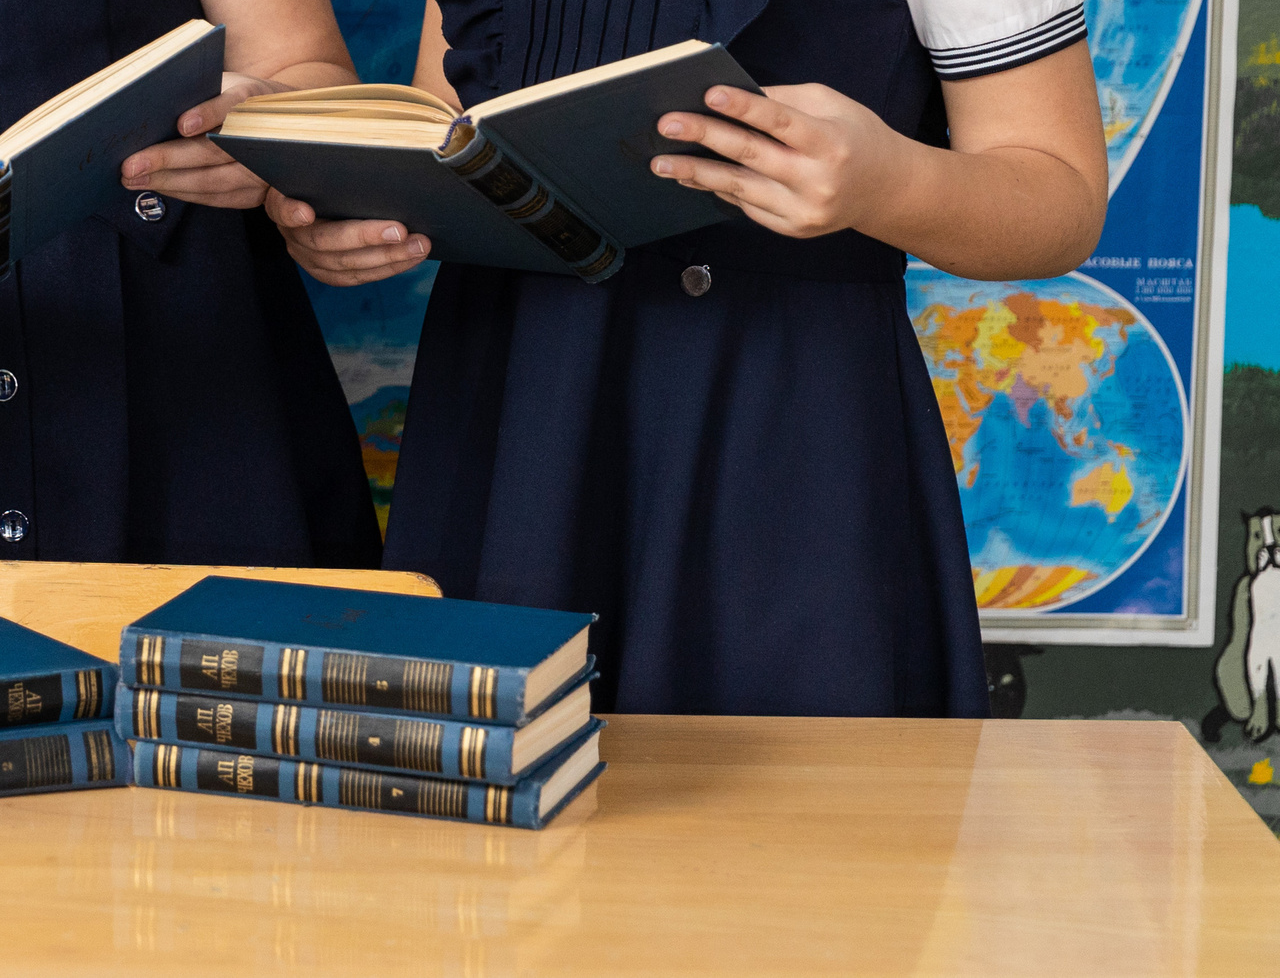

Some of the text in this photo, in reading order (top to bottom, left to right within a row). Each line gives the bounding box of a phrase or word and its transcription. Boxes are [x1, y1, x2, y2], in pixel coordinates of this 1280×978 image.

[1082, 256, 1194, 270] АСОВЫЕ ПОЯСА
[221, 649, 239, 688] ЧЕХОВ
[376, 679, 389, 691] 5
[216, 703, 234, 743] ЧЕХОВ
[368, 736, 381, 747] 4
[1, 760, 13, 772] 2
[237, 755, 255, 794] ЧЕХОВ
[391, 787, 404, 798] 7
